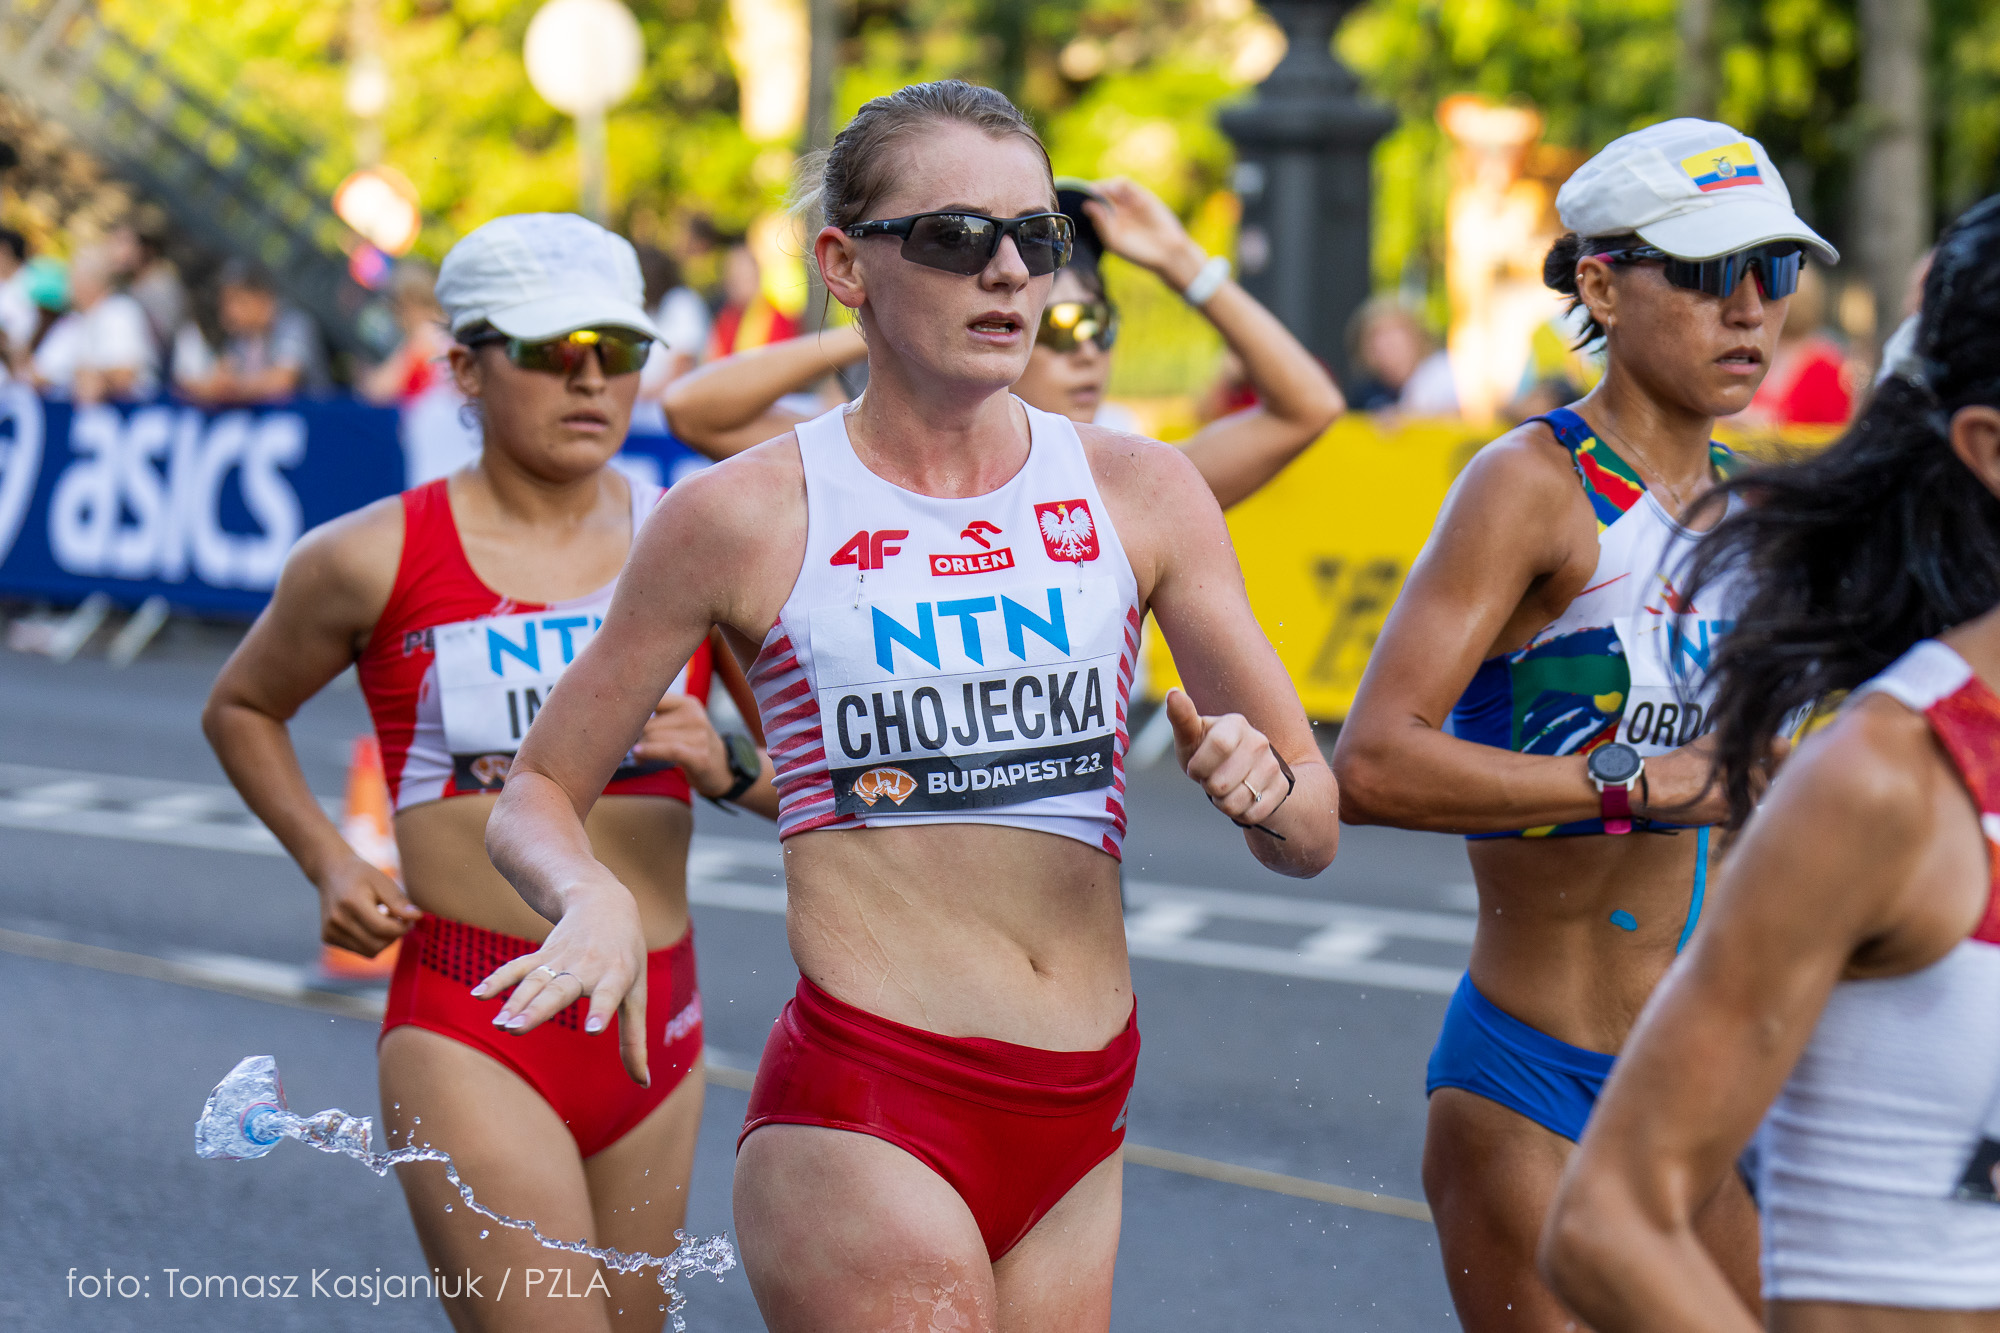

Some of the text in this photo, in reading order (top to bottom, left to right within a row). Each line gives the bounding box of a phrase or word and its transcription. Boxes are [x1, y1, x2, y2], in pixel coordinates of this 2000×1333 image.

[48, 403, 307, 592] asics
[829, 529, 909, 571] 4F
[934, 552, 1009, 573] ORLEN
[486, 616, 602, 677] NT
[871, 587, 1071, 675] NTN
[836, 667, 1105, 759] CHOJECKA
[1626, 701, 1718, 747] ORD
[927, 757, 1073, 795] BUDAPEST
